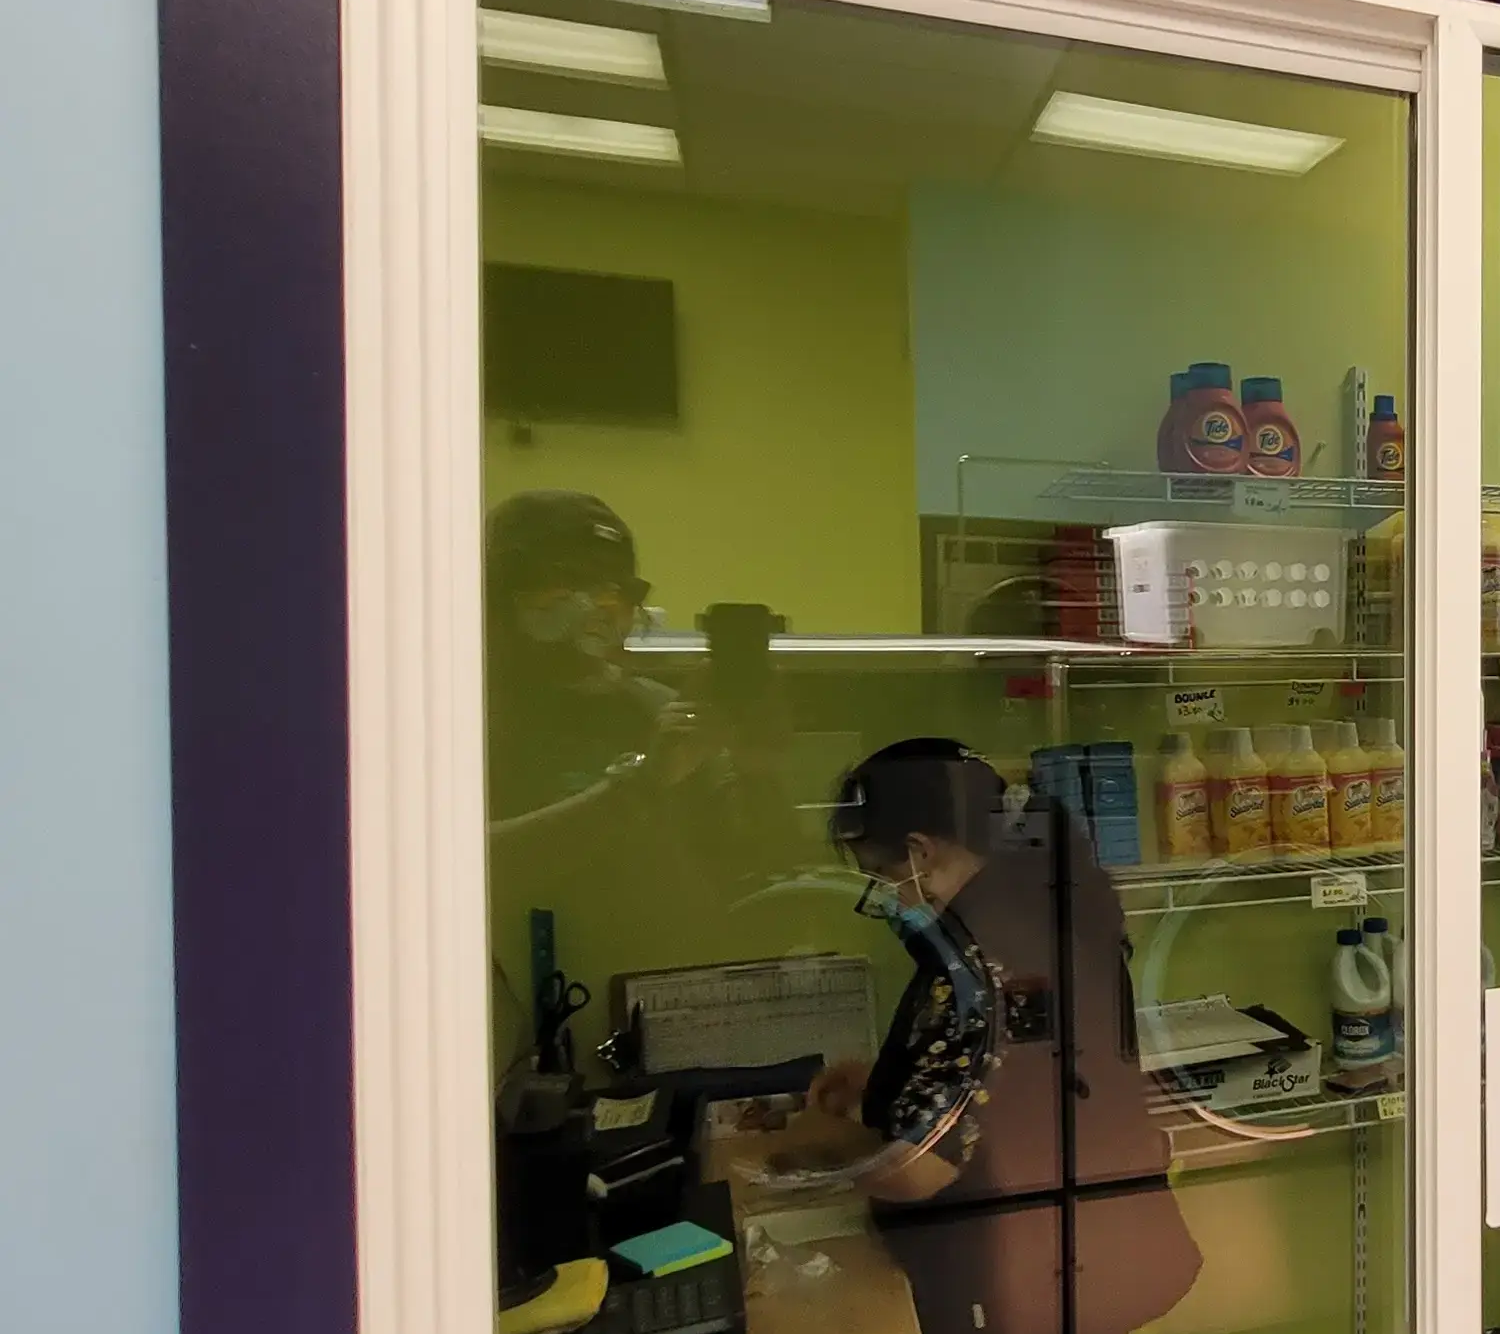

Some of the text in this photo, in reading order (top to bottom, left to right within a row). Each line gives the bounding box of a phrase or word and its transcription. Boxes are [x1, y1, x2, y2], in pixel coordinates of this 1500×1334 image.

[1204, 420, 1230, 436] Tide
[1258, 432, 1281, 448] Tide
[1380, 449, 1400, 464] Tide
[1174, 689, 1216, 704] BOUNCE
